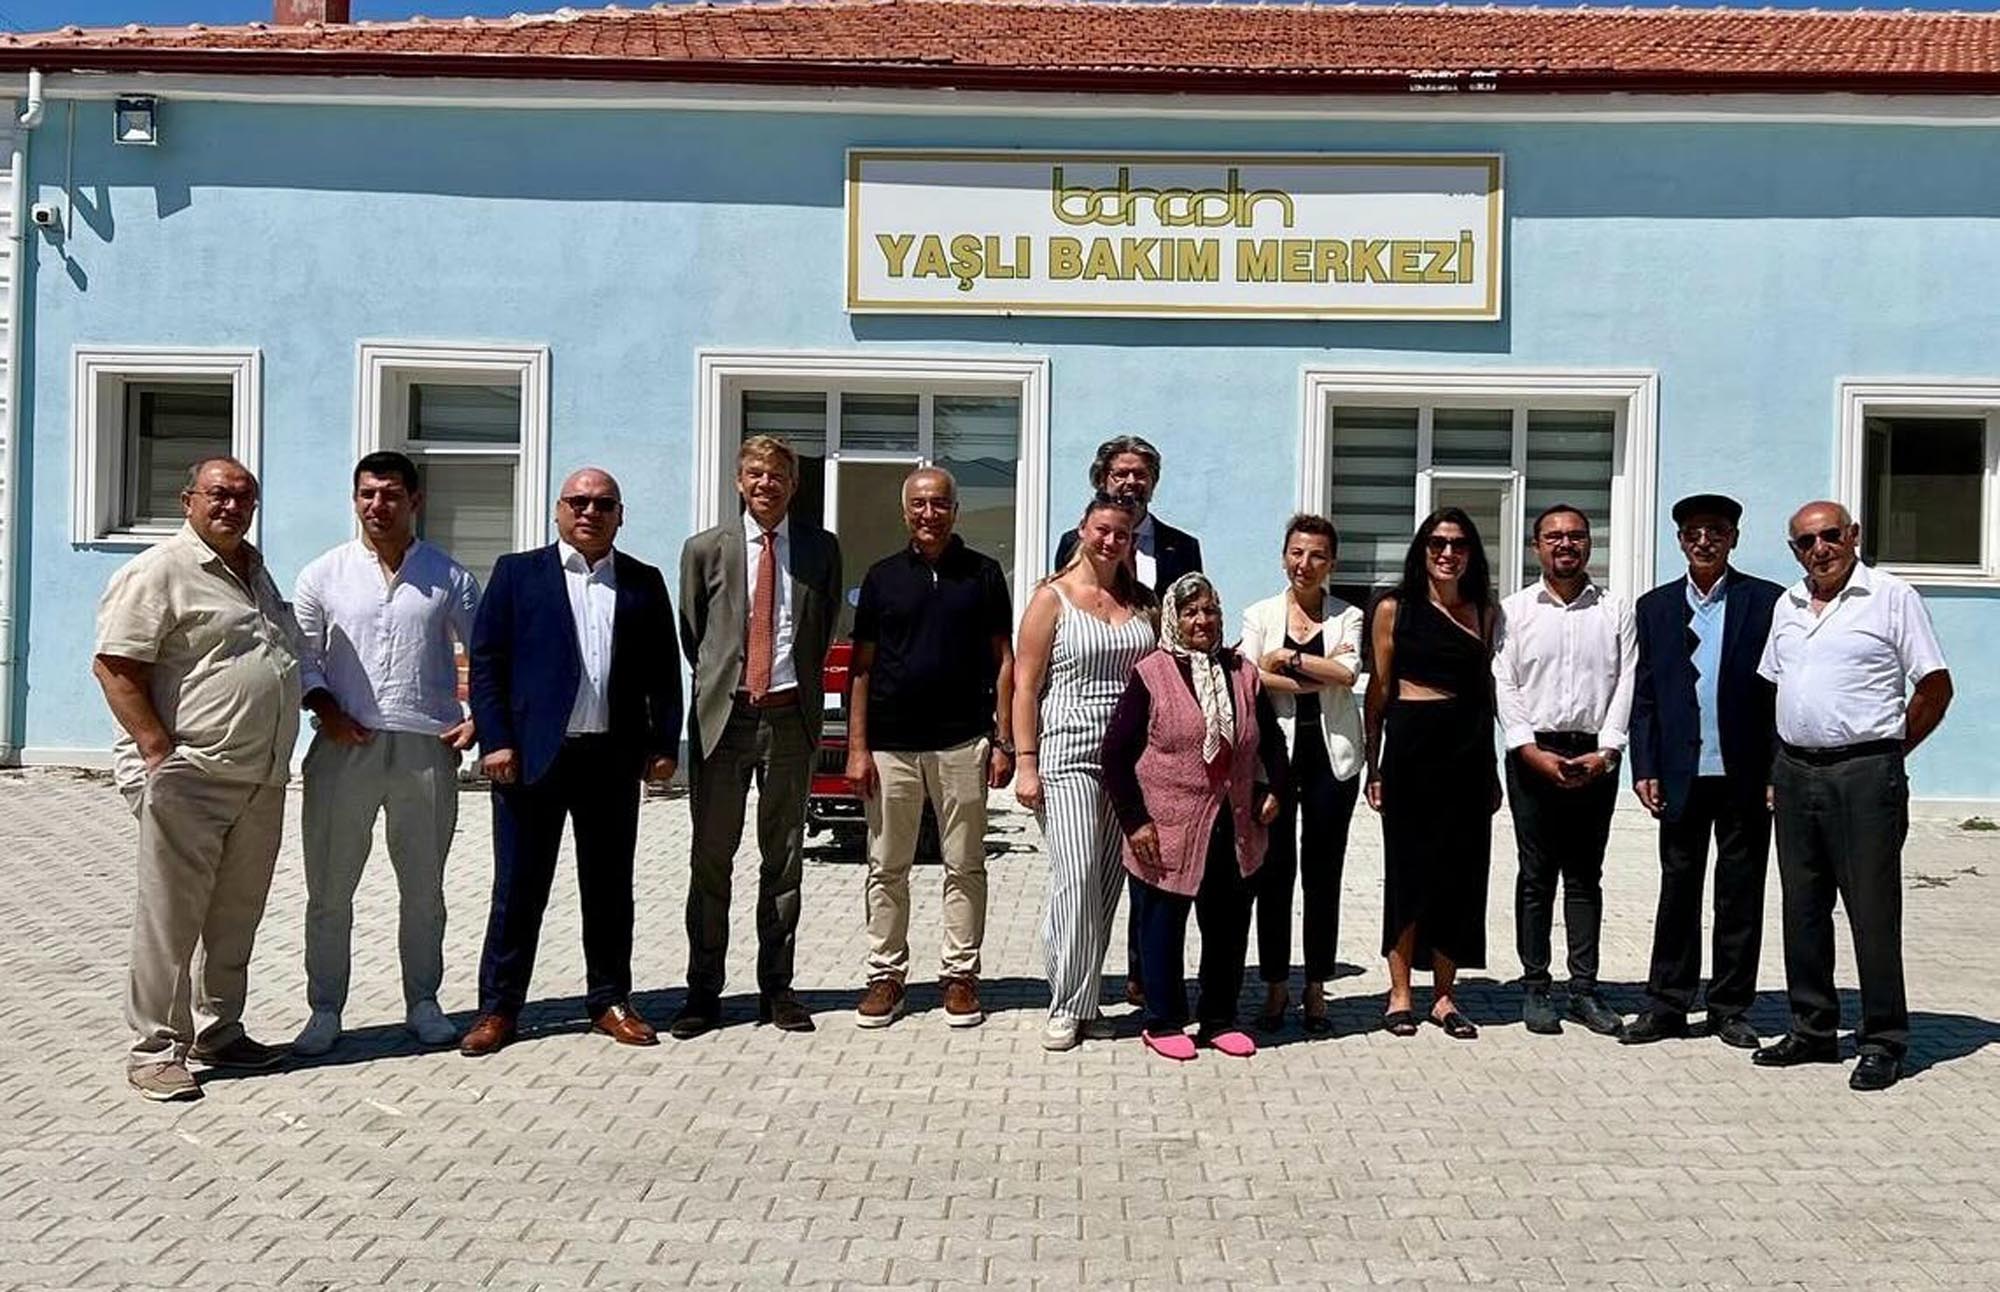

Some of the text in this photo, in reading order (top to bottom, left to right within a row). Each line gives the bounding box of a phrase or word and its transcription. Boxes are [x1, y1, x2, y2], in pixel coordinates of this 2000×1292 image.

[876, 230, 1474, 291] YAŞLI BAKIM MERKEZİ
